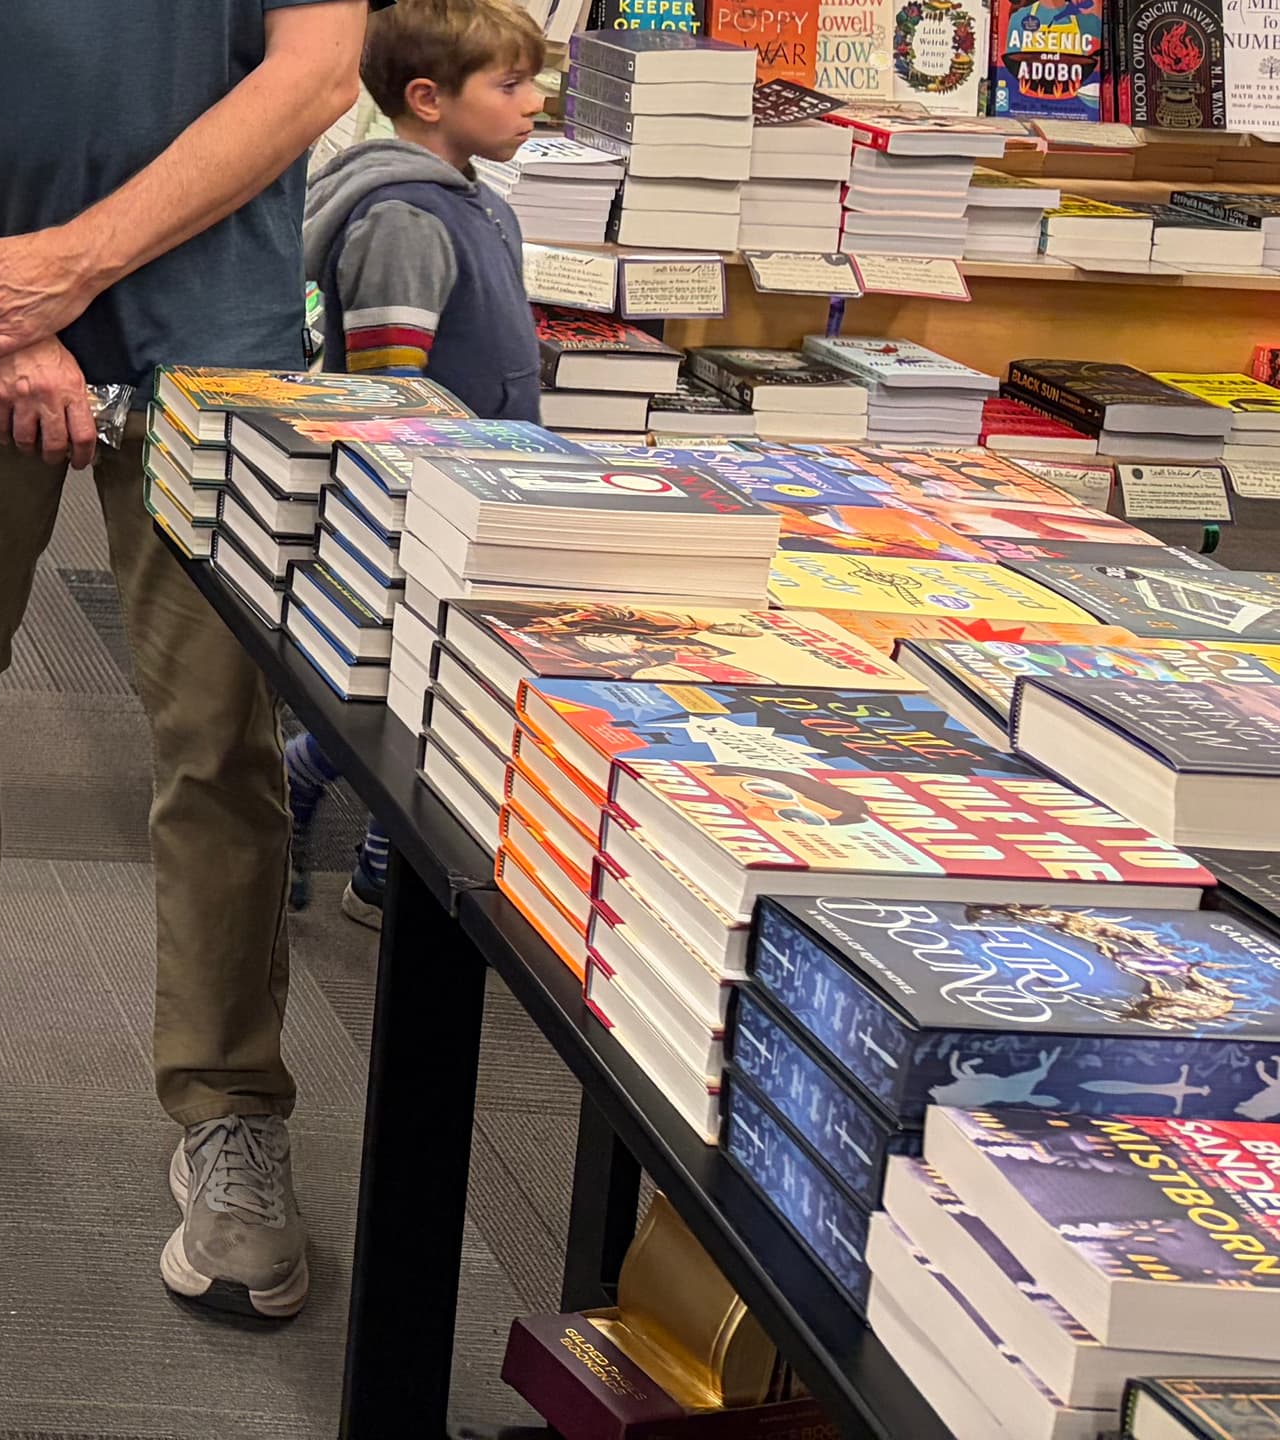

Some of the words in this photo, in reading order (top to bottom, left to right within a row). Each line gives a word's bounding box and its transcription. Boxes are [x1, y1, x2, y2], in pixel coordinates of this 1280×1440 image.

[717, 9, 809, 34] POPPY
[923, 27, 946, 36] Little
[1138, 2, 1178, 32] BRIGHT
[1182, 0, 1216, 34] HAVEN
[744, 41, 807, 66] WAR
[919, 37, 949, 47] Weirds
[1008, 30, 1092, 51] ARSENIC
[1040, 52, 1060, 60] and
[1133, 33, 1146, 70] OVER
[1018, 61, 1083, 81] ADOBO
[1134, 73, 1148, 121] BLOOD
[1012, 369, 1040, 393] BLACK
[1040, 384, 1061, 402] SUN
[901, 772, 1024, 823] RULE
[992, 779, 1141, 830] HOW
[827, 776, 1008, 861] WORLD
[815, 896, 1053, 1023] BOUND
[1090, 1120, 1280, 1275] MISTBORN
[560, 1336, 628, 1396] BOOKENDS
